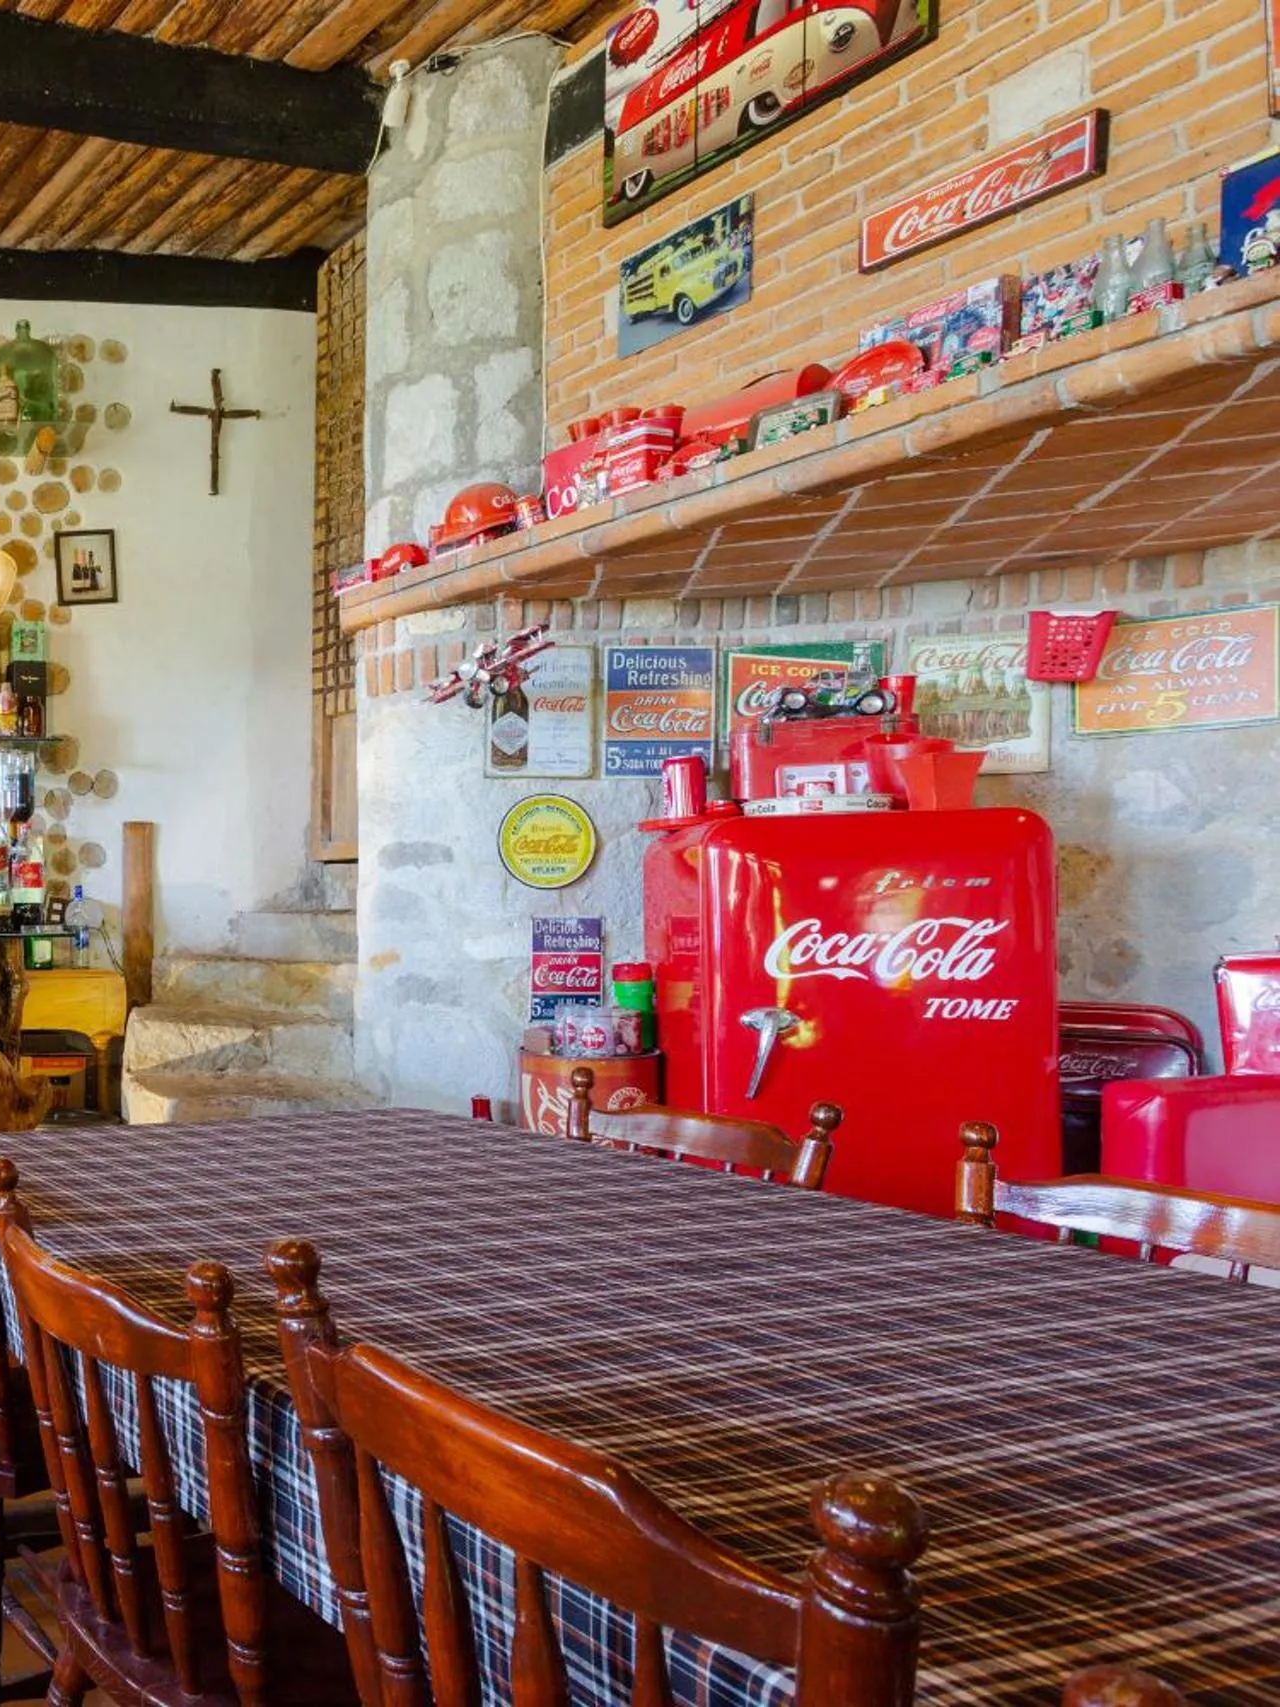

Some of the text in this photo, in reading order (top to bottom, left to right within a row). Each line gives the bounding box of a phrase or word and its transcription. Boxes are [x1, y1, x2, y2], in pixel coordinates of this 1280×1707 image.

[883, 149, 1055, 256] Coca-Cola
[612, 651, 687, 670] Delicious
[750, 662, 782, 676] ICE
[1096, 633, 1258, 681] Coca-Cola
[627, 668, 712, 689] Refreshing
[533, 695, 588, 713] Coca-Cola
[1144, 689, 1191, 723] 5
[610, 704, 709, 733] Coca-Cola
[534, 919, 585, 935] Delicious
[543, 934, 600, 950] Refreshing
[763, 917, 1010, 981] Coca-Cola
[533, 963, 600, 988] Coca-Cola
[922, 997, 1019, 1022] TOME
